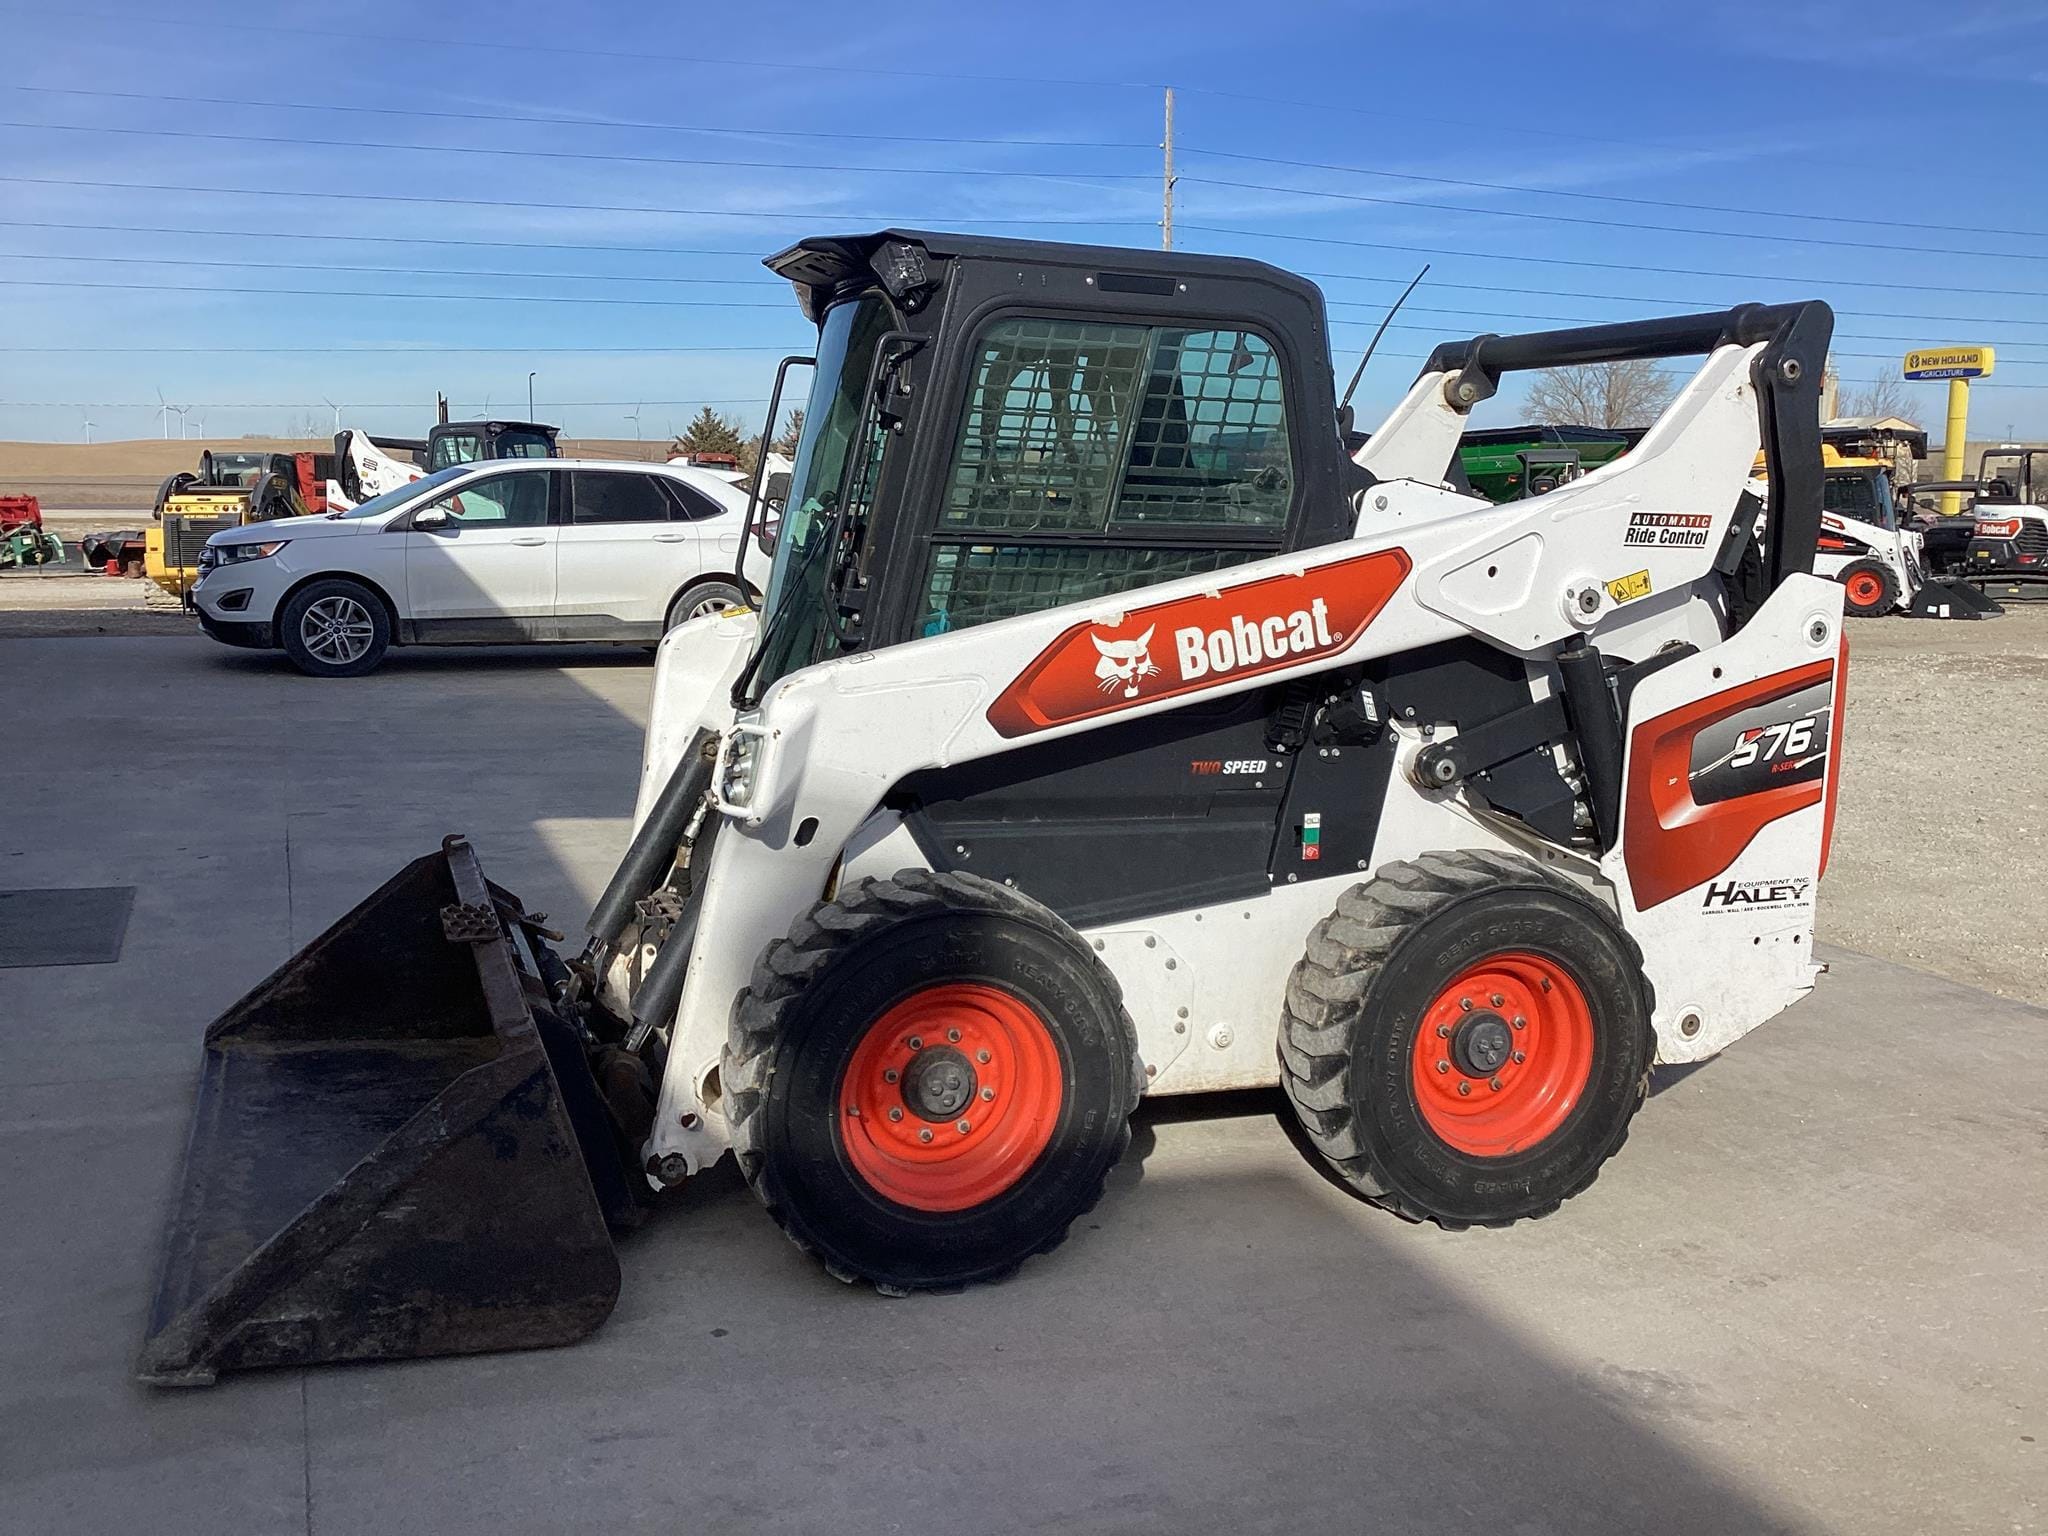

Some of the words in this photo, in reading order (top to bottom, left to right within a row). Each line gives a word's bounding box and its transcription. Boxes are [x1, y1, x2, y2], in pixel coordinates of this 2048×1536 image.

[1921, 356, 1940, 366] NEW
[1941, 354, 1979, 365] HOLLAND
[1920, 368, 1964, 378] AGRICULTURE
[1632, 513, 1710, 527] AUTOMATIC
[1981, 523, 2010, 534] Bobcat
[1624, 527, 1656, 544] Ride
[1660, 528, 1709, 545] Control
[1175, 598, 1333, 681] Bobcat
[1729, 717, 1816, 769] S76
[1190, 760, 1221, 774] TWO
[1222, 760, 1268, 774] SPEED
[1737, 878, 1791, 889] EQUIPMENT
[1703, 881, 1809, 908] HALEY
